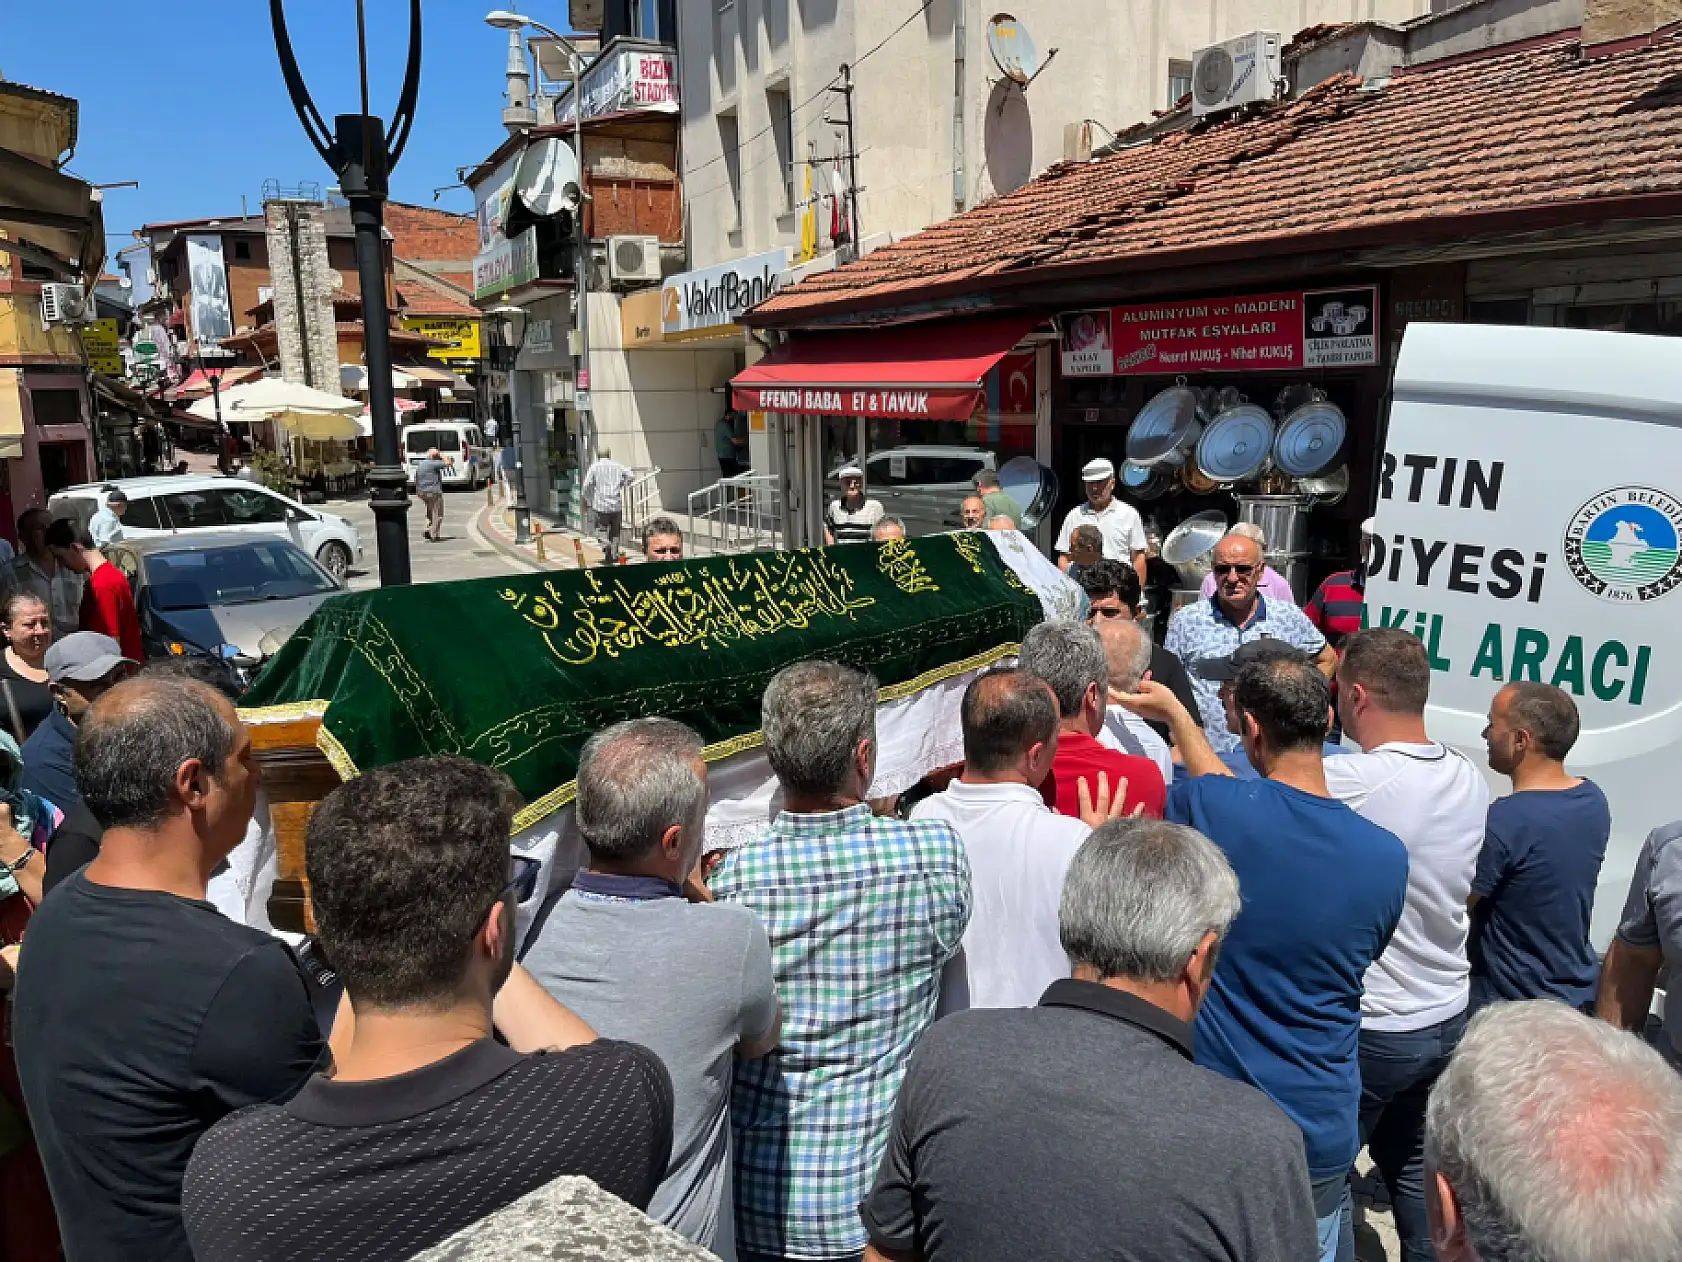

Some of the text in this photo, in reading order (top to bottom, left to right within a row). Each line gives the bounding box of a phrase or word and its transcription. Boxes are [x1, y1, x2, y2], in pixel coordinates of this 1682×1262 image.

[684, 264, 778, 317] VakıfBank
[1213, 307, 1230, 316] ve
[1140, 321, 1276, 341] MUTFAK EŞYALARI
[759, 388, 928, 413] EFENDİ BABA ET & TAVUK
[1573, 494, 1617, 536] BARTIN
[1470, 622, 1652, 705] ARACI
